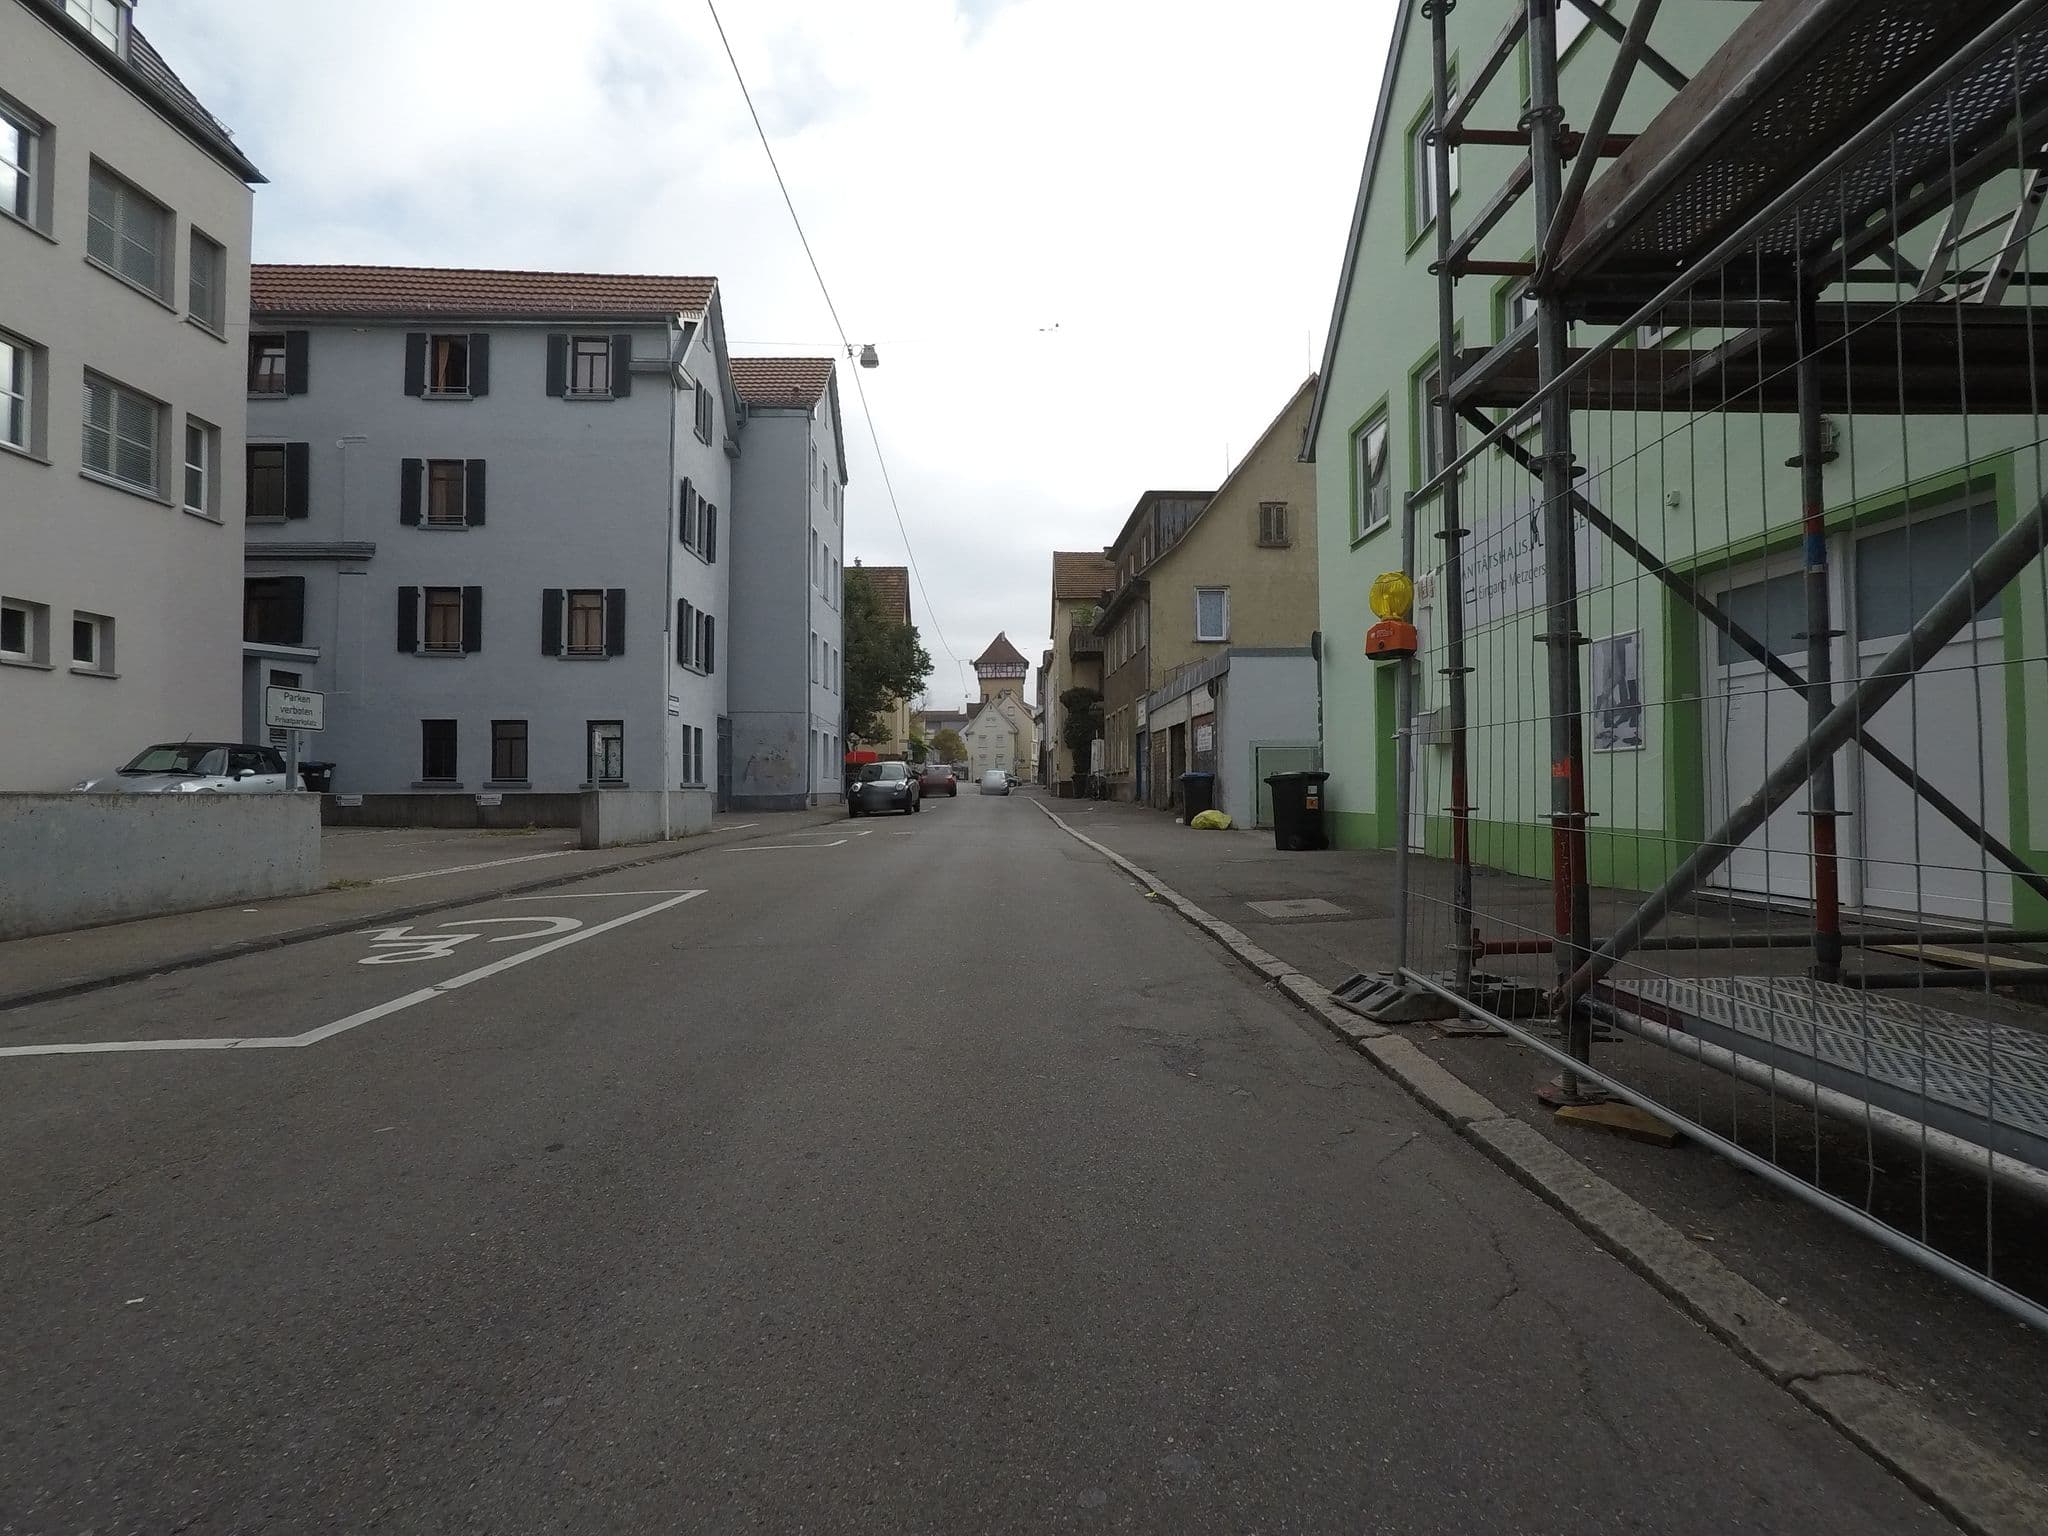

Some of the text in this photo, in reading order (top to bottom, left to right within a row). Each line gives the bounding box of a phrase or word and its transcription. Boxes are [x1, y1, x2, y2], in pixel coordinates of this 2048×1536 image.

[1462, 539, 1529, 580] ANTÄTSHAUS
[1478, 564, 1549, 600] Eingang Metzgers
[284, 691, 311, 704] Parken
[280, 705, 313, 716] verboten
